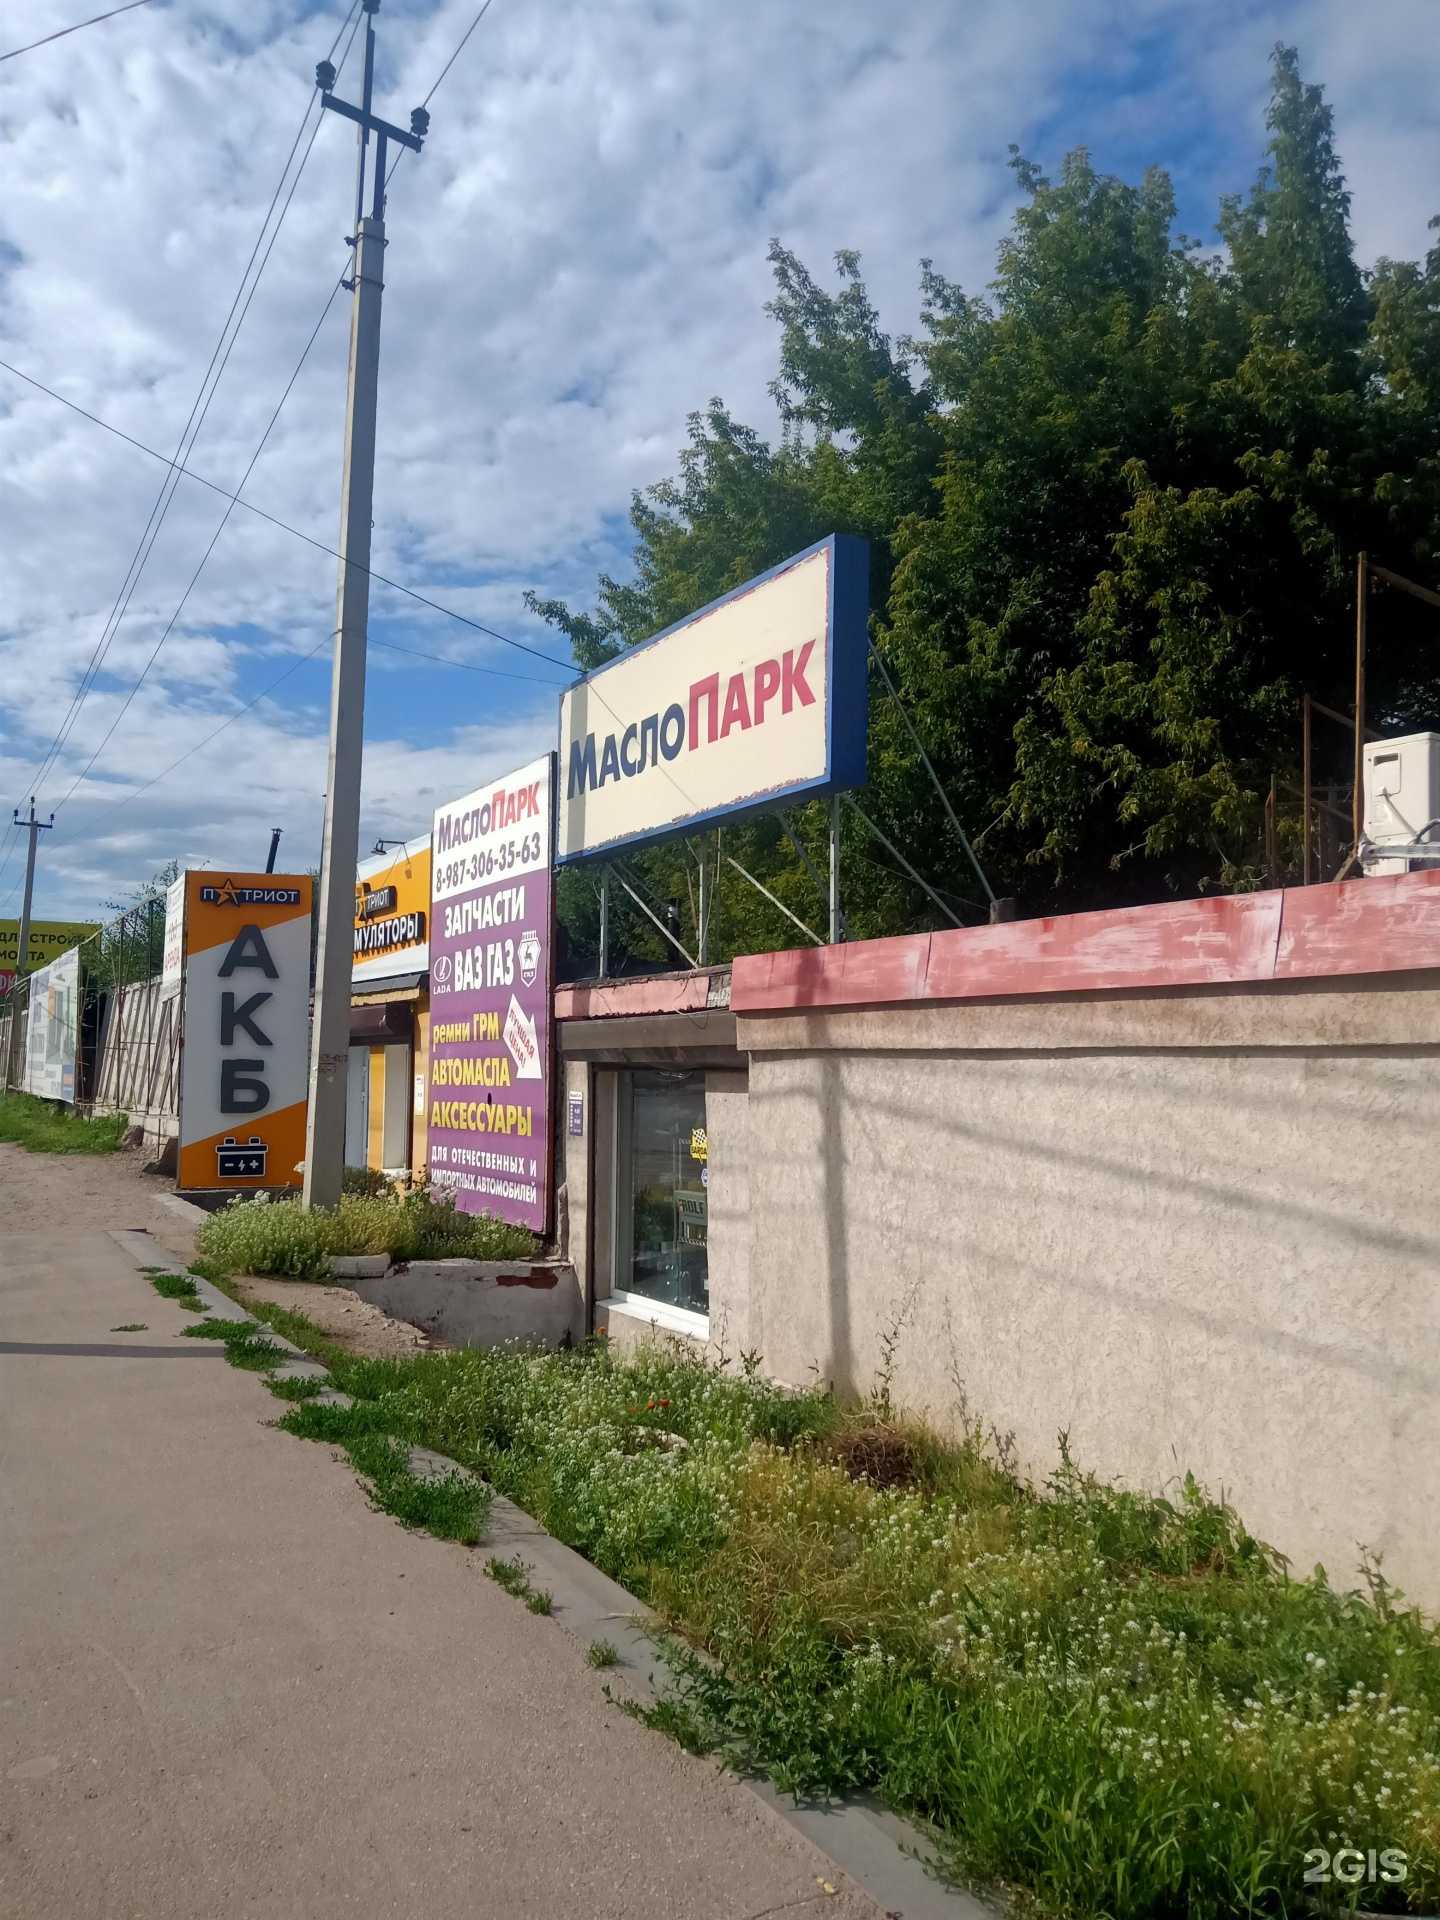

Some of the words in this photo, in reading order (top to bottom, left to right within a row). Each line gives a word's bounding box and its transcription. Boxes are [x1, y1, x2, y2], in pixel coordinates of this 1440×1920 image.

[436, 832, 541, 892] 8-987-306-35-63
[444, 885, 526, 939] ЗАПЧАСТИ
[454, 945, 483, 992] ВАЗ
[486, 938, 514, 988] ГАЗ
[433, 984, 451, 995] LADA
[433, 1023, 470, 1053] ремни
[473, 1012, 500, 1041] ГРМ
[432, 1057, 511, 1087] АВТОМАСЛА
[431, 1101, 532, 1137] АКСЕССУАРЫ
[431, 1145, 448, 1163] ДЛЯ
[451, 1147, 525, 1176] ОТЕЧЕСТВЕННЫХ
[530, 1160, 537, 1178] И
[431, 1168, 475, 1190] ИМПОРТНЫХ
[476, 1175, 537, 1204] АВТОМОБИЛЕЙ
